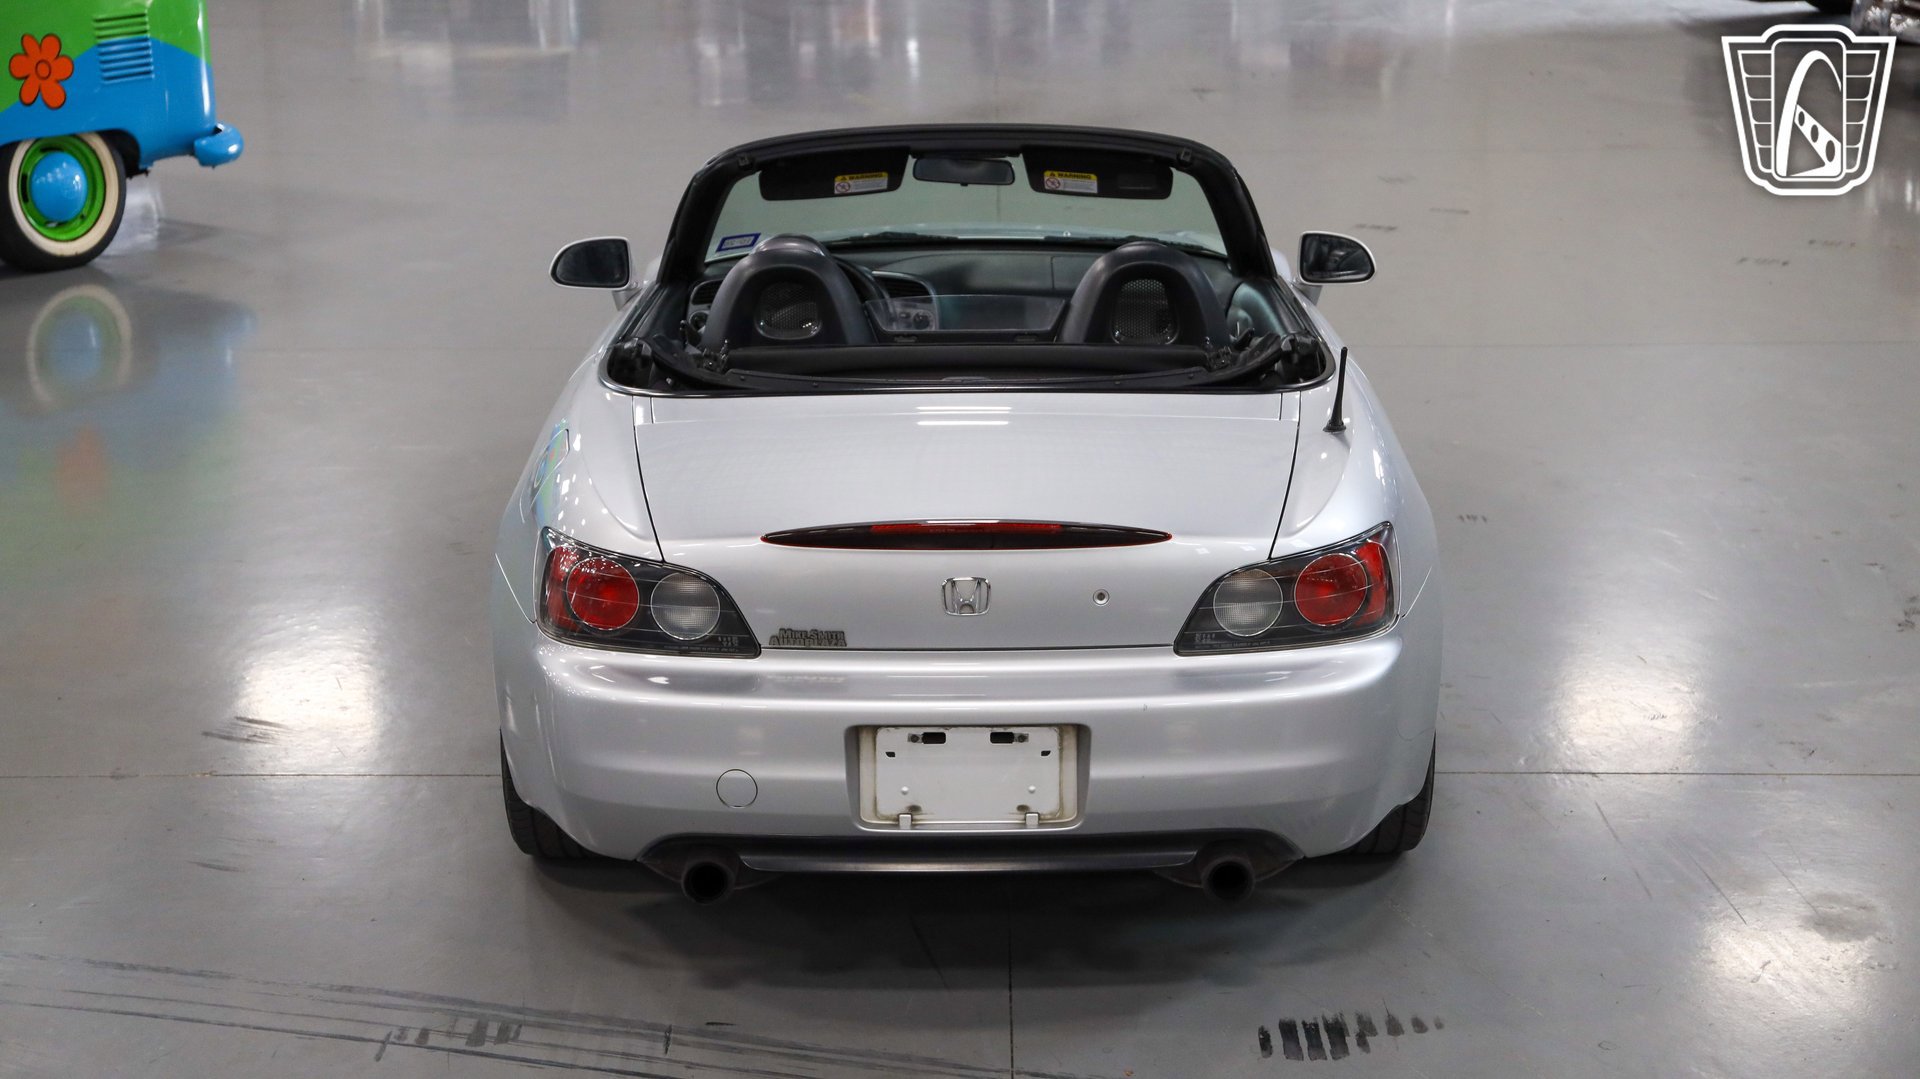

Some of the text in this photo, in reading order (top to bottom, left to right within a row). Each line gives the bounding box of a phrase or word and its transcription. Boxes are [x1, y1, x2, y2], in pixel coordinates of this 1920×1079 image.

[1058, 172, 1091, 180] WARNING
[779, 628, 845, 640] MIKE SMITH
